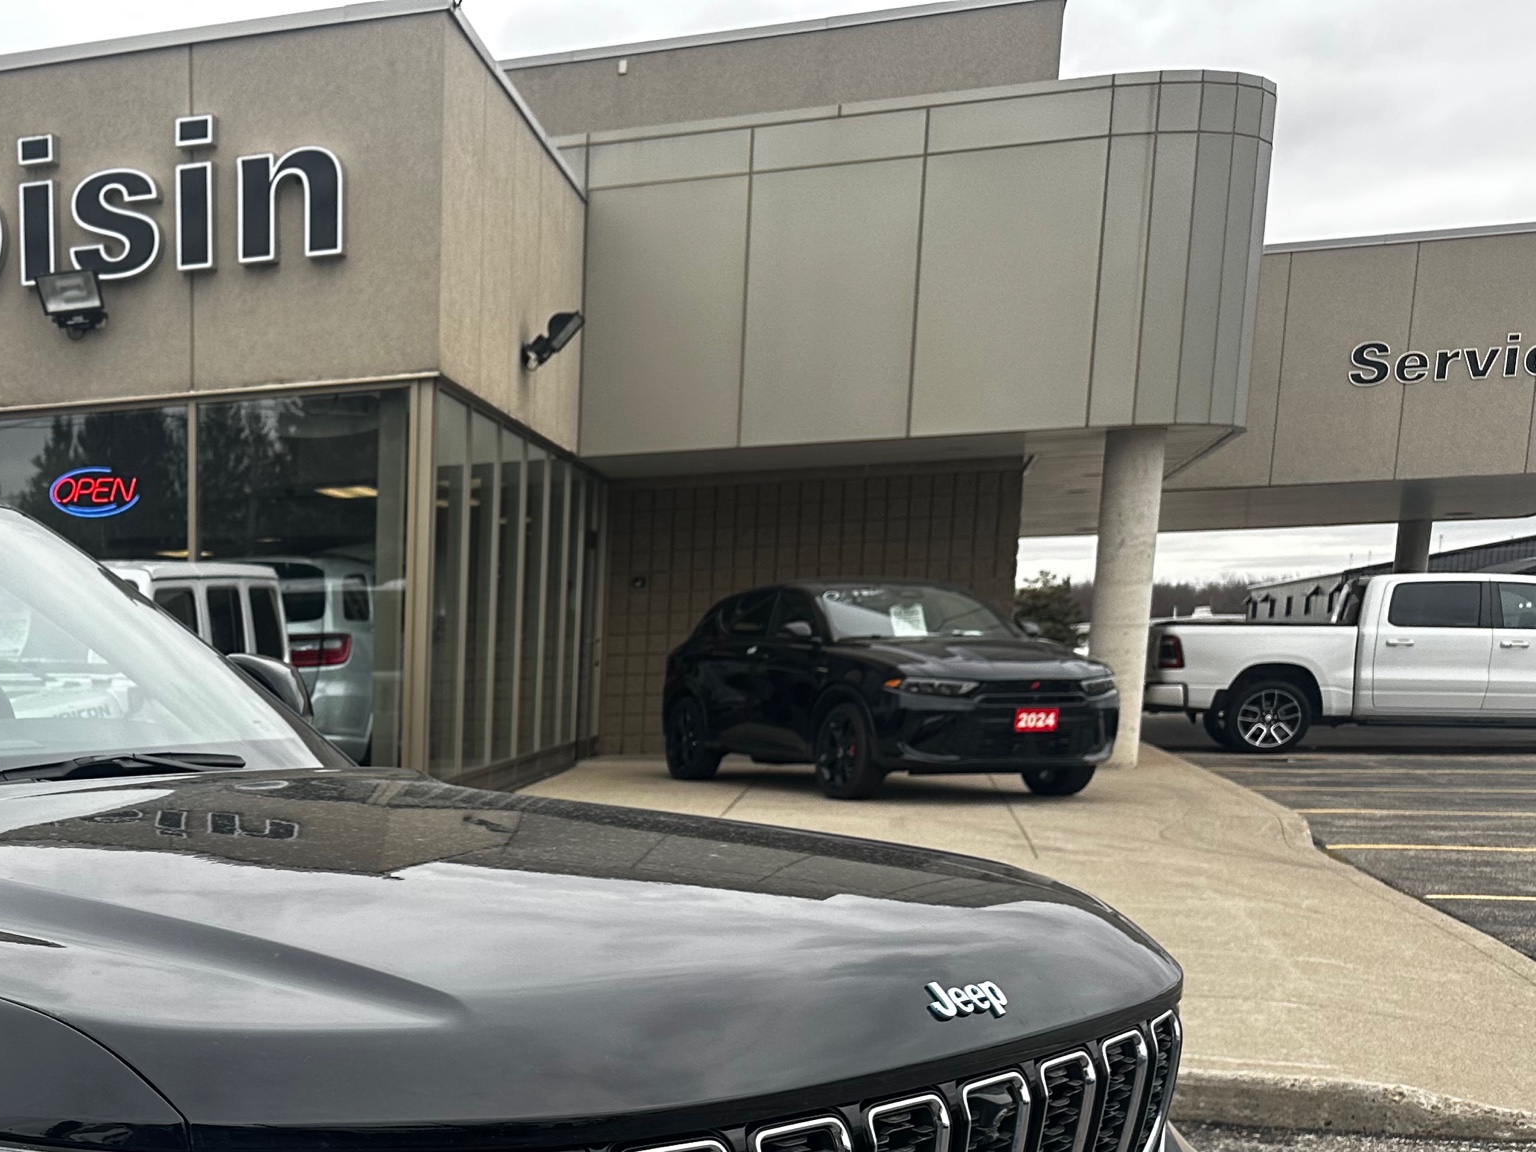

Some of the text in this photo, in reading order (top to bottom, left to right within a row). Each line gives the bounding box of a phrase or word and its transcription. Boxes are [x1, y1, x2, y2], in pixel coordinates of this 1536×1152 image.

[52, 476, 138, 504] OPEN
[1016, 711, 1056, 728] 2024
[924, 981, 1008, 1021] Jeep
